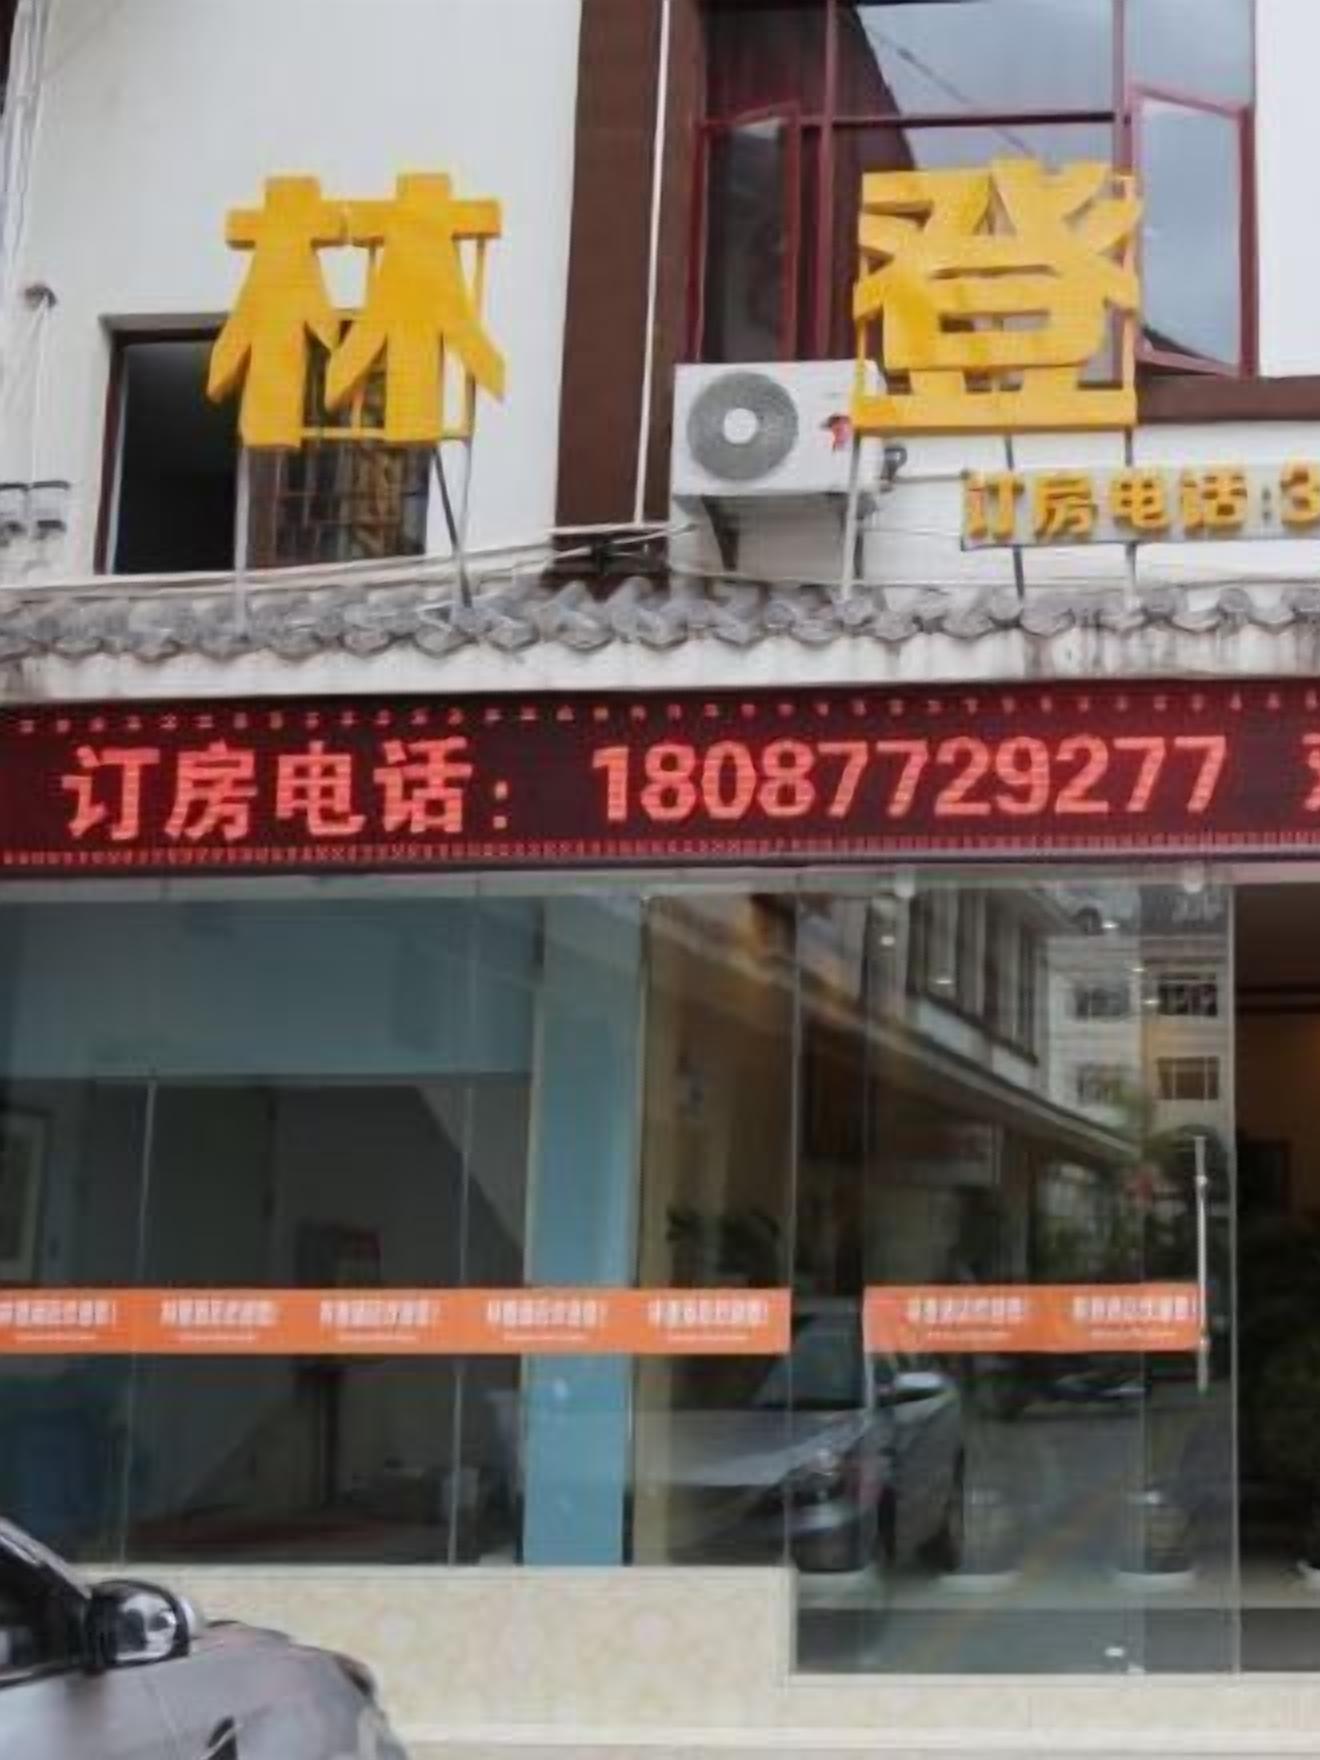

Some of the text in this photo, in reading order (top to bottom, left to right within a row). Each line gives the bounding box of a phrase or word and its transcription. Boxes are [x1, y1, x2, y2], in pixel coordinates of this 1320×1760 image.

[61, 735, 510, 841] 订房电话:
[592, 734, 1226, 821] 18087729277
